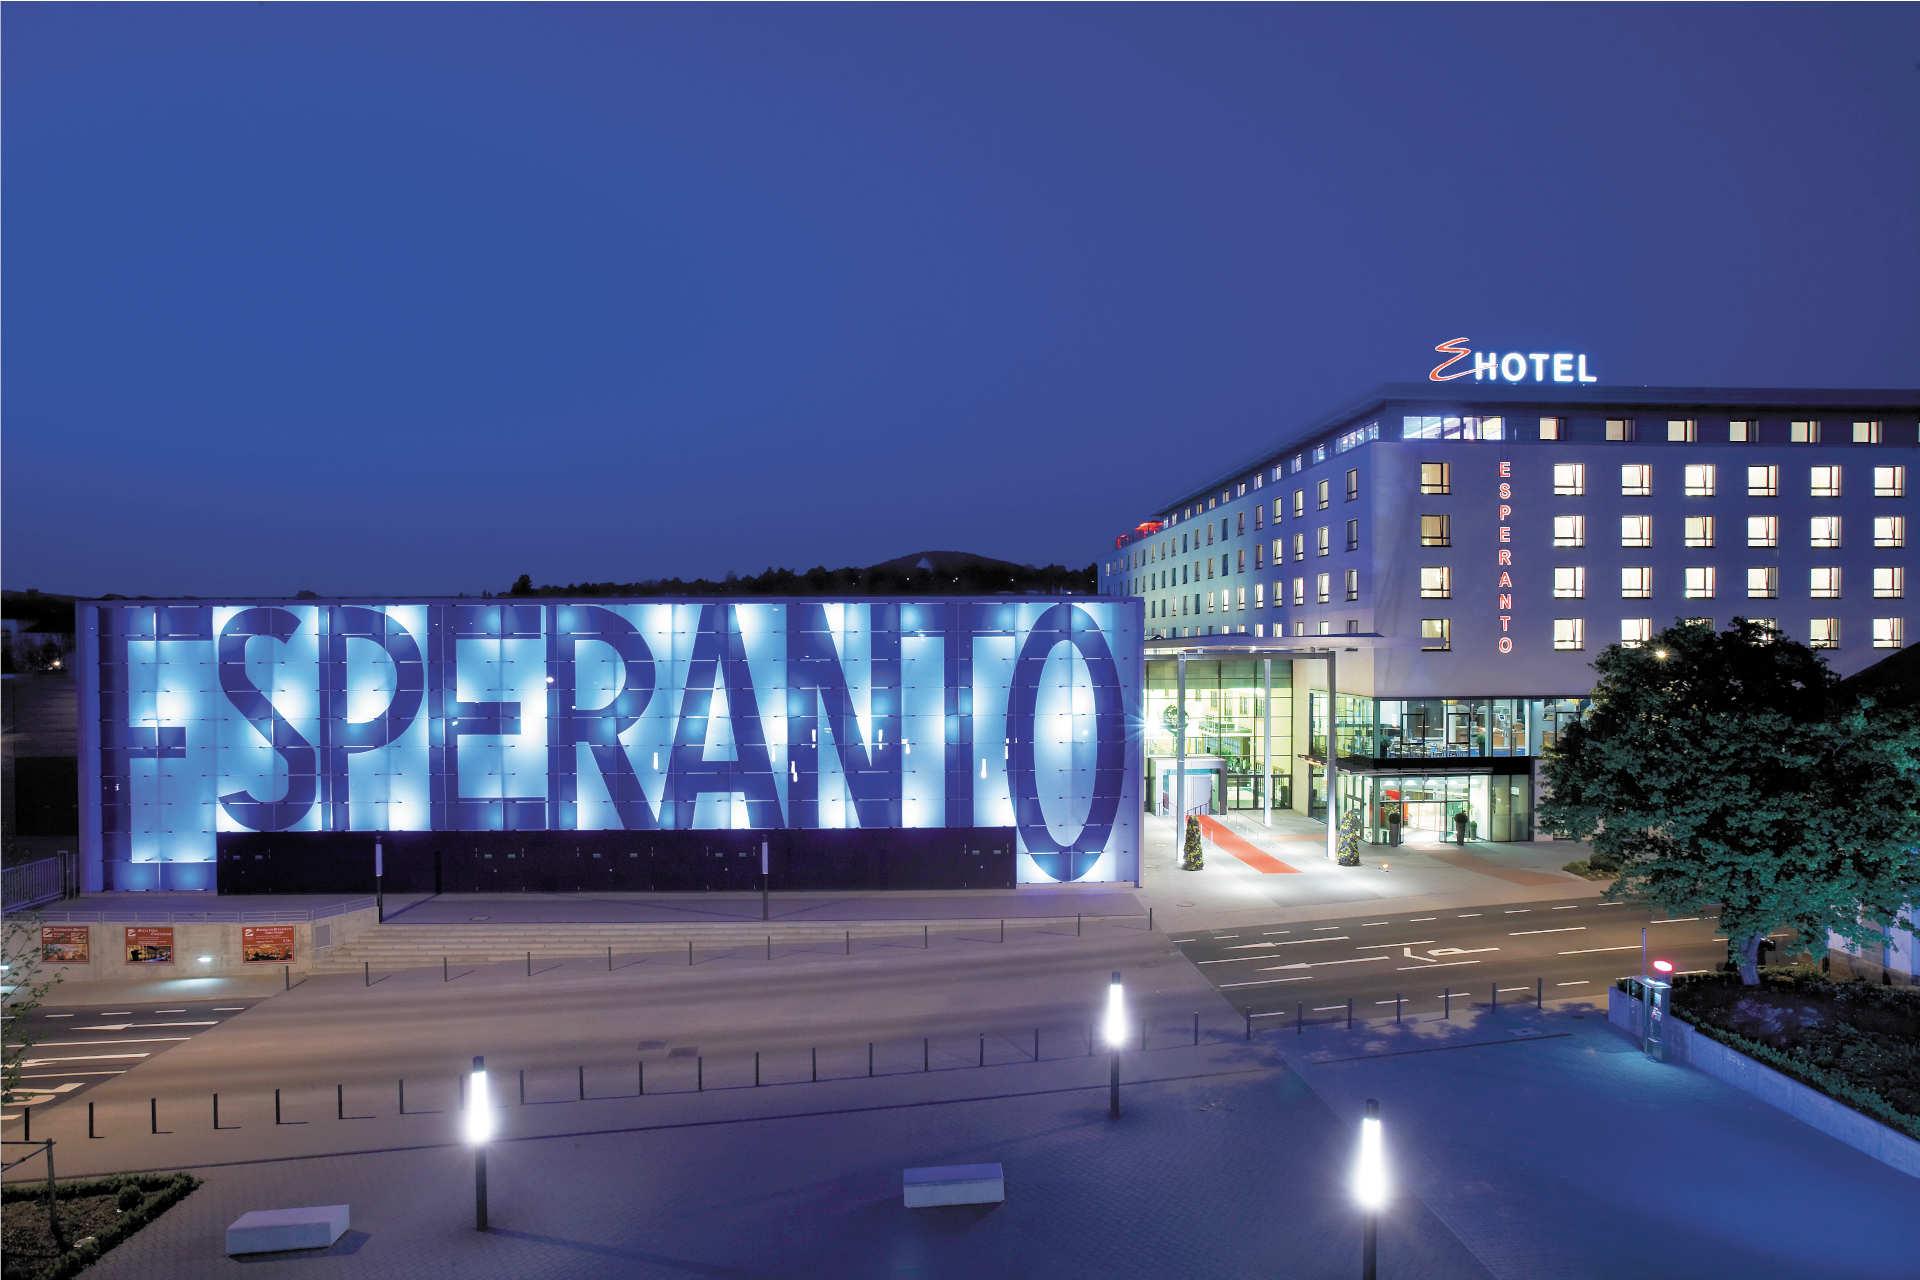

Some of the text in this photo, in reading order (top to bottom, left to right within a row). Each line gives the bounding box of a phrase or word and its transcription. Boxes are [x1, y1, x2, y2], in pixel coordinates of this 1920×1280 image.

[1474, 351, 1598, 382] HOTEL
[1498, 461, 1512, 654] ESPERANTO
[101, 603, 1125, 891] ESPERANTO
